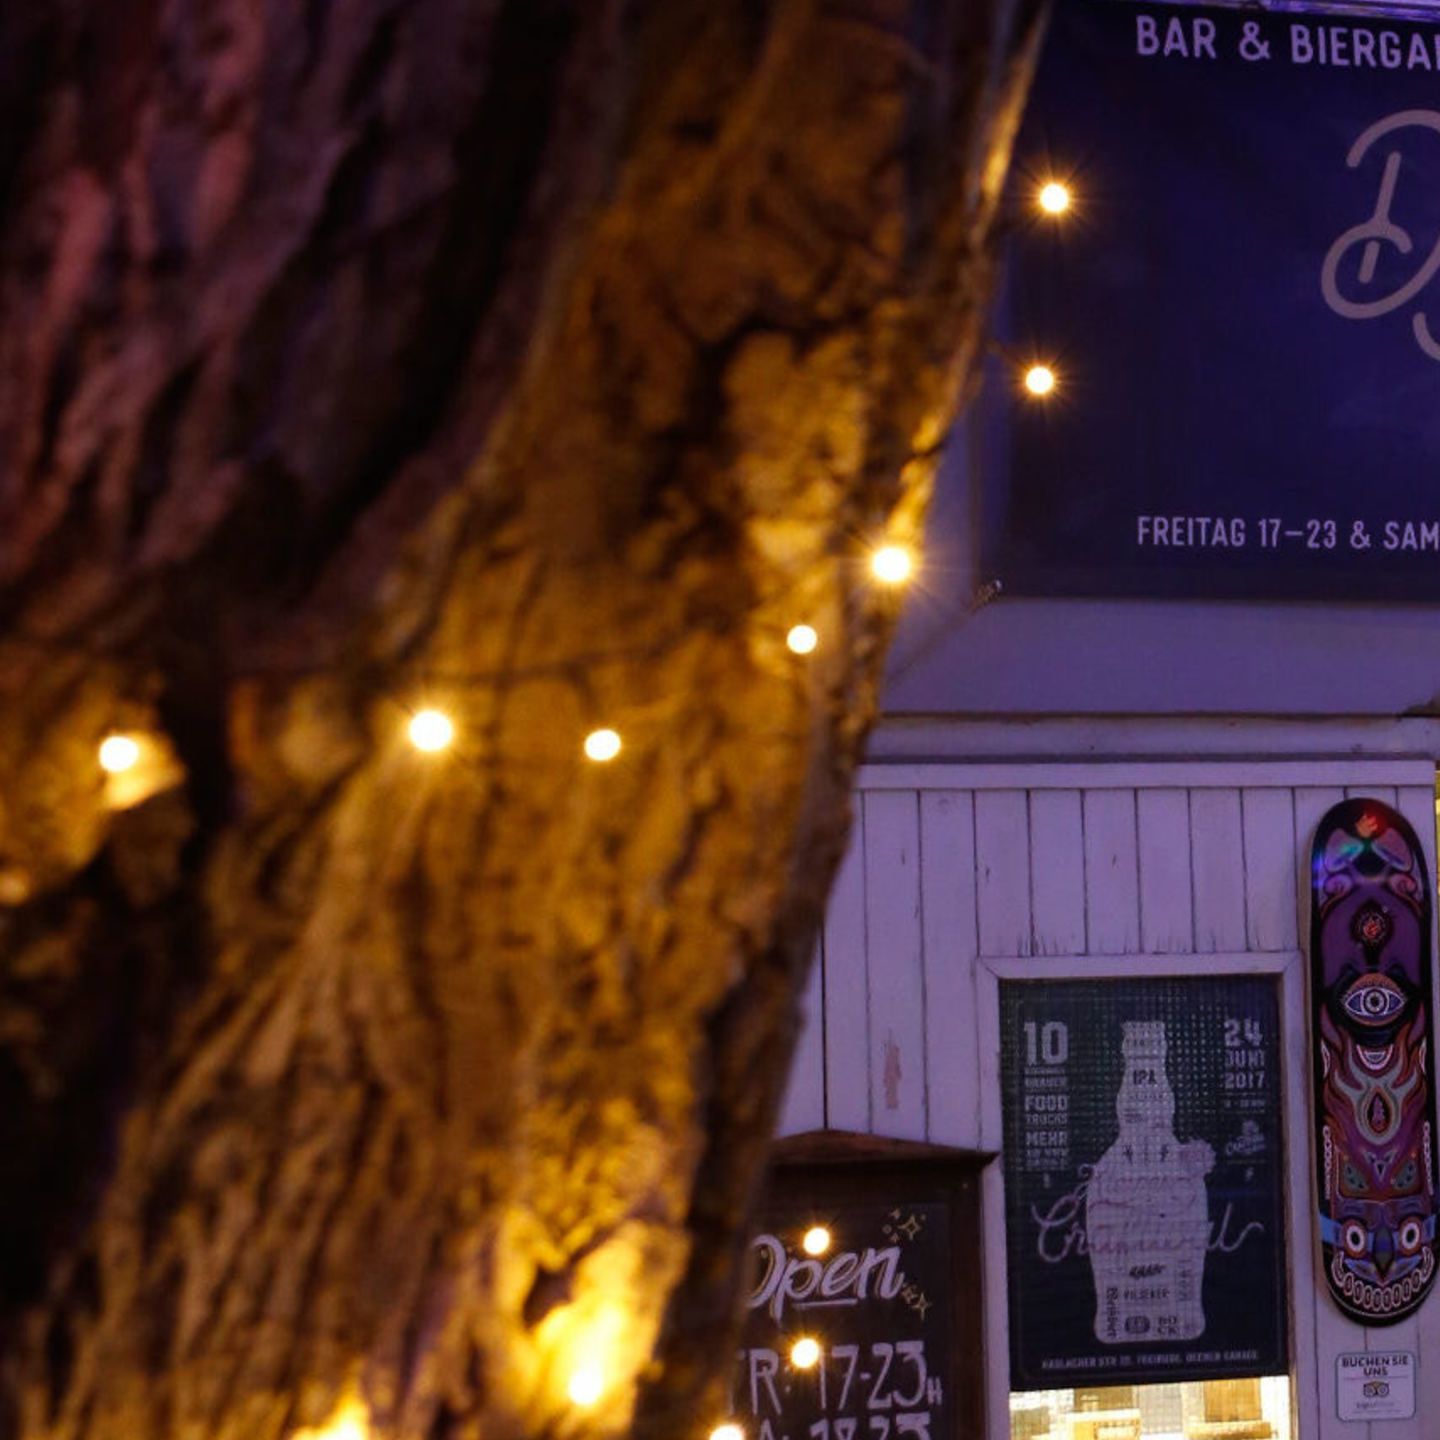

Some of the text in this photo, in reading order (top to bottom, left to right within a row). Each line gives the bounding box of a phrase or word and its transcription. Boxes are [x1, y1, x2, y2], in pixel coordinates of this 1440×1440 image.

[1136, 15, 1216, 59] BAR
[1239, 21, 1271, 61] &
[1137, 516, 1246, 547] FREITAG
[1350, 520, 1371, 550] &
[1024, 1020, 1069, 1066] 10
[1223, 1018, 1263, 1047] 24
[1132, 1070, 1158, 1086] IPA
[1224, 1071, 1265, 1090] 2017
[1024, 1094, 1069, 1112] FOOD
[1363, 1366, 1389, 1377] UNS
